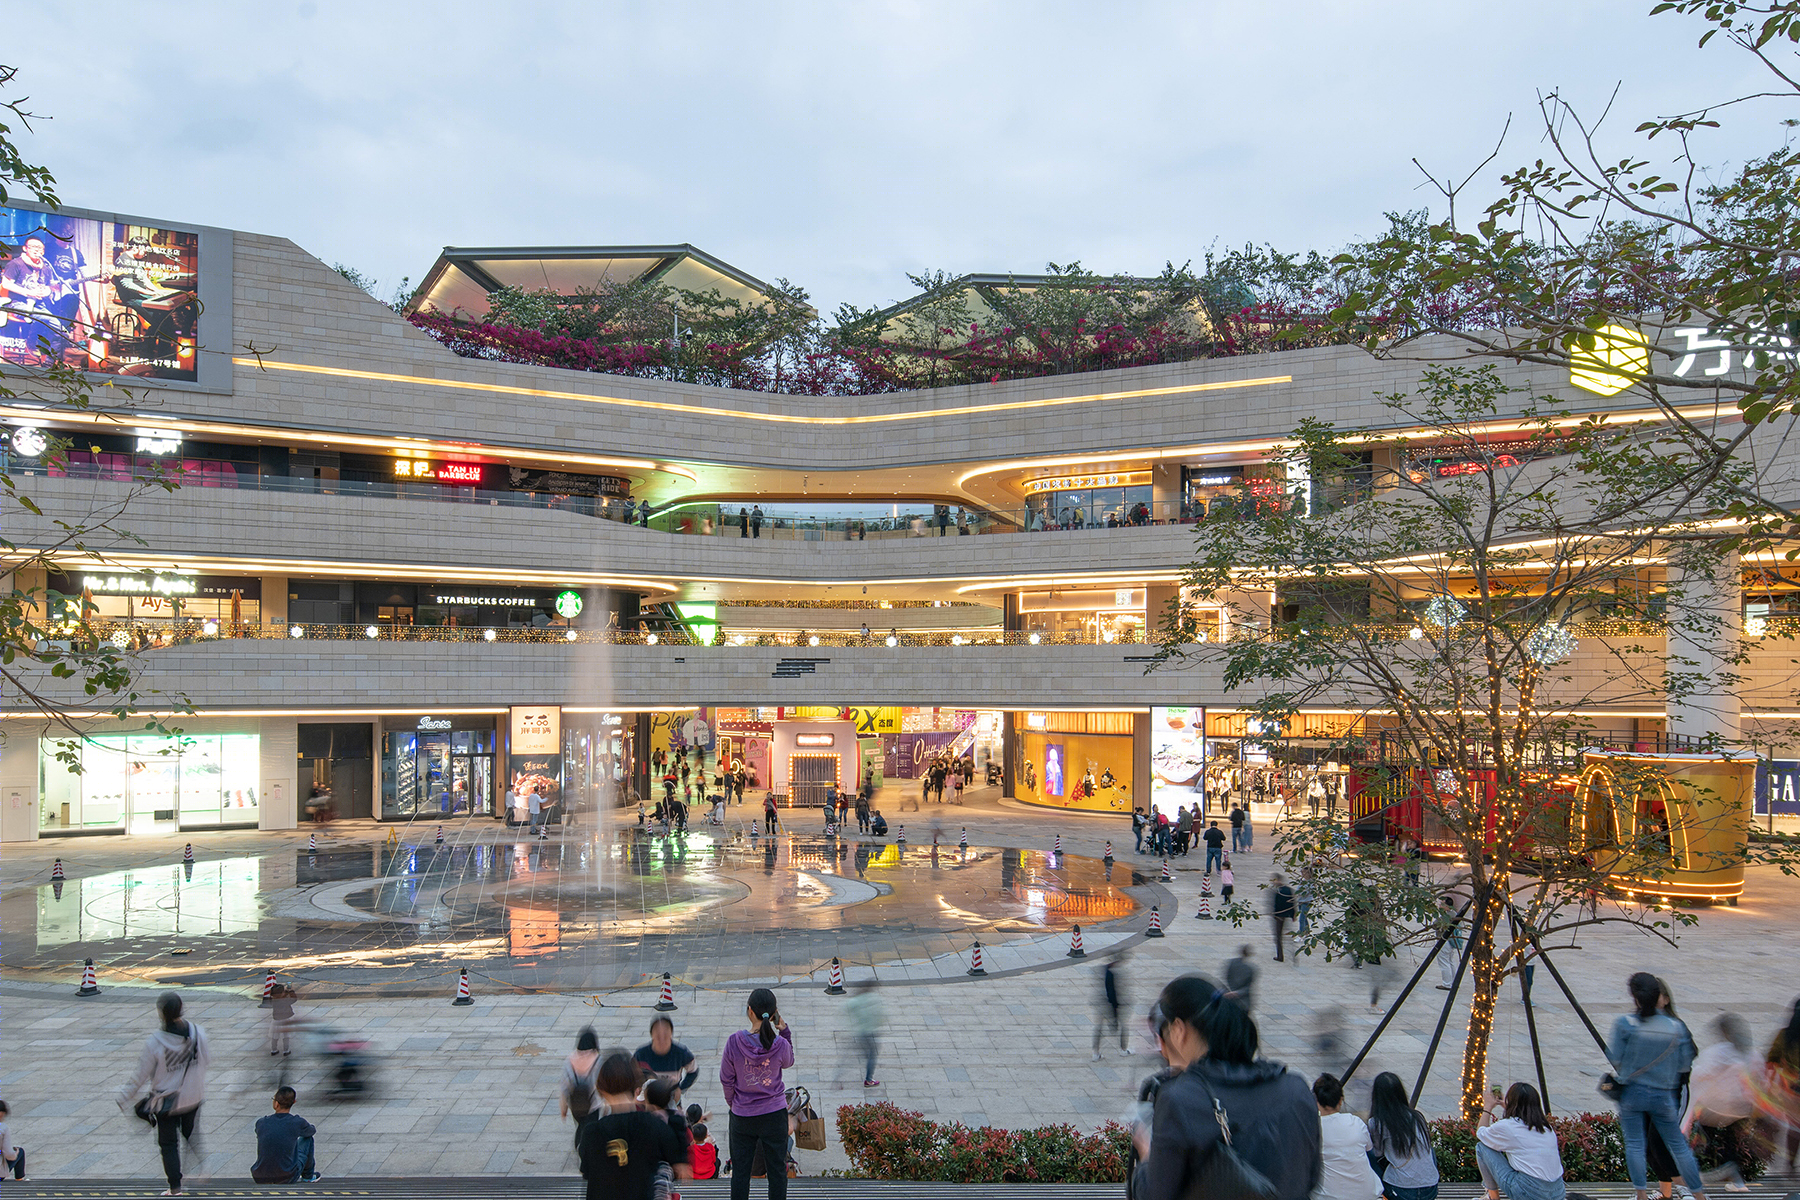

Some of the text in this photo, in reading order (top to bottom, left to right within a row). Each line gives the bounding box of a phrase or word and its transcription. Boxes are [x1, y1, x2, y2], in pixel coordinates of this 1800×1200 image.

[394, 460, 429, 477] 探炉
[447, 465, 467, 473] TAN
[438, 470, 480, 481] BARBECUE
[601, 484, 620, 493] RIDE
[436, 596, 536, 607] STARBUCKS COFFEE
[1768, 774, 1800, 802] GA
